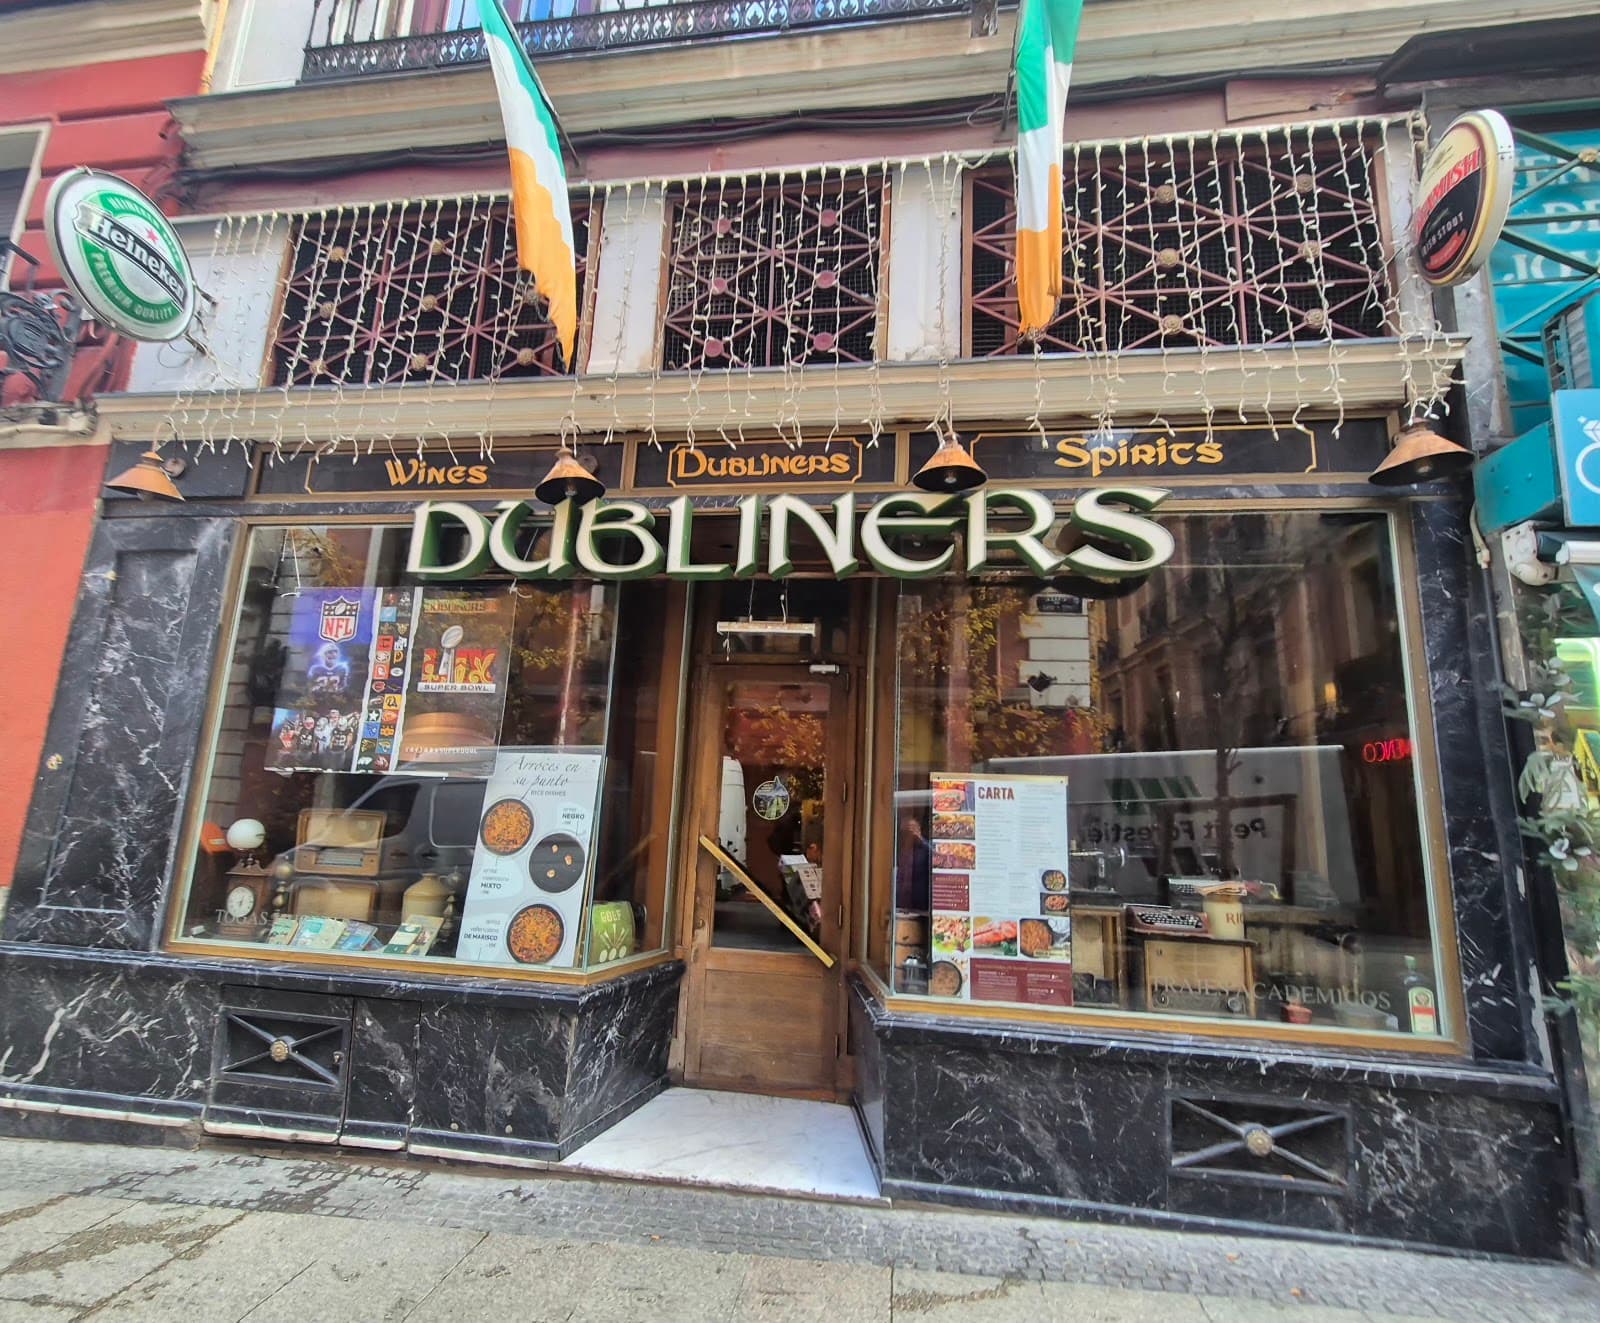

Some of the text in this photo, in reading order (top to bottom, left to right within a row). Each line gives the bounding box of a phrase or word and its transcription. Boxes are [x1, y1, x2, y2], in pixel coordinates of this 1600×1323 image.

[91, 211, 185, 299] Heineken
[406, 486, 1176, 581] DUBLINERS
[324, 617, 353, 639] NFL
[424, 683, 489, 692] SUPER BOWL
[505, 755, 580, 773] Arroces en
[978, 786, 1015, 800] CARTA
[600, 909, 622, 922] GOLF
